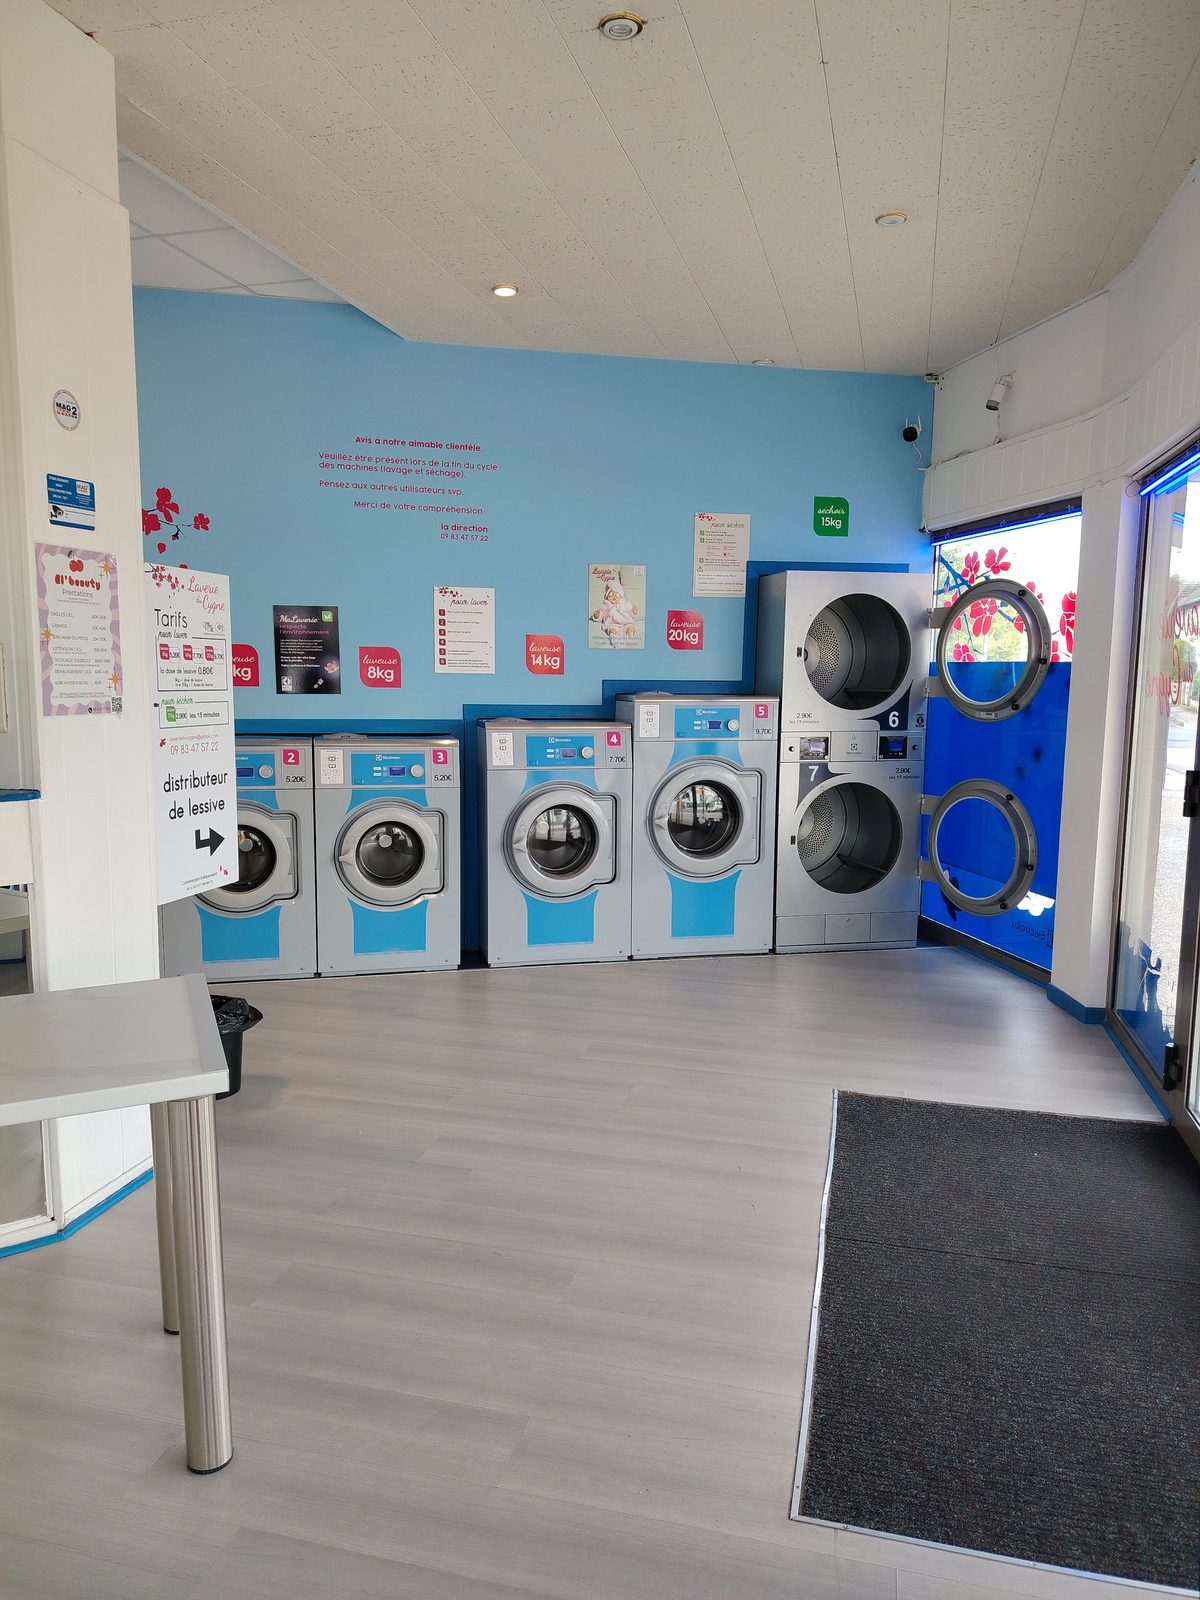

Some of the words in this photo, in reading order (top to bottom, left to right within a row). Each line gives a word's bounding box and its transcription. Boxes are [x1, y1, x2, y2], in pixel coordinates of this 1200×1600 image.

[356, 436, 372, 444] Avis
[375, 436, 381, 445] à
[383, 438, 406, 447] notre
[409, 440, 443, 449] aimable
[318, 452, 353, 461] Veuillez
[355, 454, 373, 463] être
[376, 455, 408, 466] présent
[410, 458, 427, 466] lors
[429, 459, 439, 467] de
[441, 460, 450, 468] la
[452, 460, 462, 469] fin
[464, 461, 475, 469] du
[477, 462, 498, 471] cycle
[318, 462, 335, 470] des
[337, 462, 378, 472] machines
[380, 464, 413, 476] (lavage
[415, 467, 424, 475] et
[319, 480, 350, 489] Pensez
[352, 482, 368, 490] aux
[370, 483, 398, 491] autres
[400, 484, 446, 495] utilisateurs
[448, 488, 464, 496] svp.
[354, 500, 378, 509] Merci
[381, 502, 391, 510] de
[393, 503, 416, 511] votre
[818, 506, 847, 515] séchoir
[452, 524, 488, 533] direction
[821, 517, 842, 529] 15kg
[440, 532, 449, 540] 09
[187, 576, 219, 595] Laverie
[62, 589, 94, 598] Prestations
[203, 594, 226, 614] Cygne
[154, 609, 188, 629] Tarifs
[671, 618, 702, 628] laveuse
[529, 642, 561, 653] laveuse
[362, 654, 398, 665] laveuse
[183, 667, 197, 675] lessive
[233, 664, 252, 681] kg
[368, 666, 394, 683] 8kg
[758, 706, 765, 716] 5
[889, 711, 899, 728] 6
[610, 734, 618, 743] 4
[170, 746, 179, 755] 09
[181, 744, 189, 754] 83
[191, 744, 199, 753] 47
[201, 742, 209, 752] 57
[211, 742, 219, 751] 22
[288, 753, 295, 763] 2
[437, 752, 444, 762] 3
[434, 774, 453, 782] 5.20€
[809, 766, 820, 782] 7
[163, 770, 228, 793] distributeur
[169, 800, 184, 820] de
[189, 798, 225, 817] lessive
